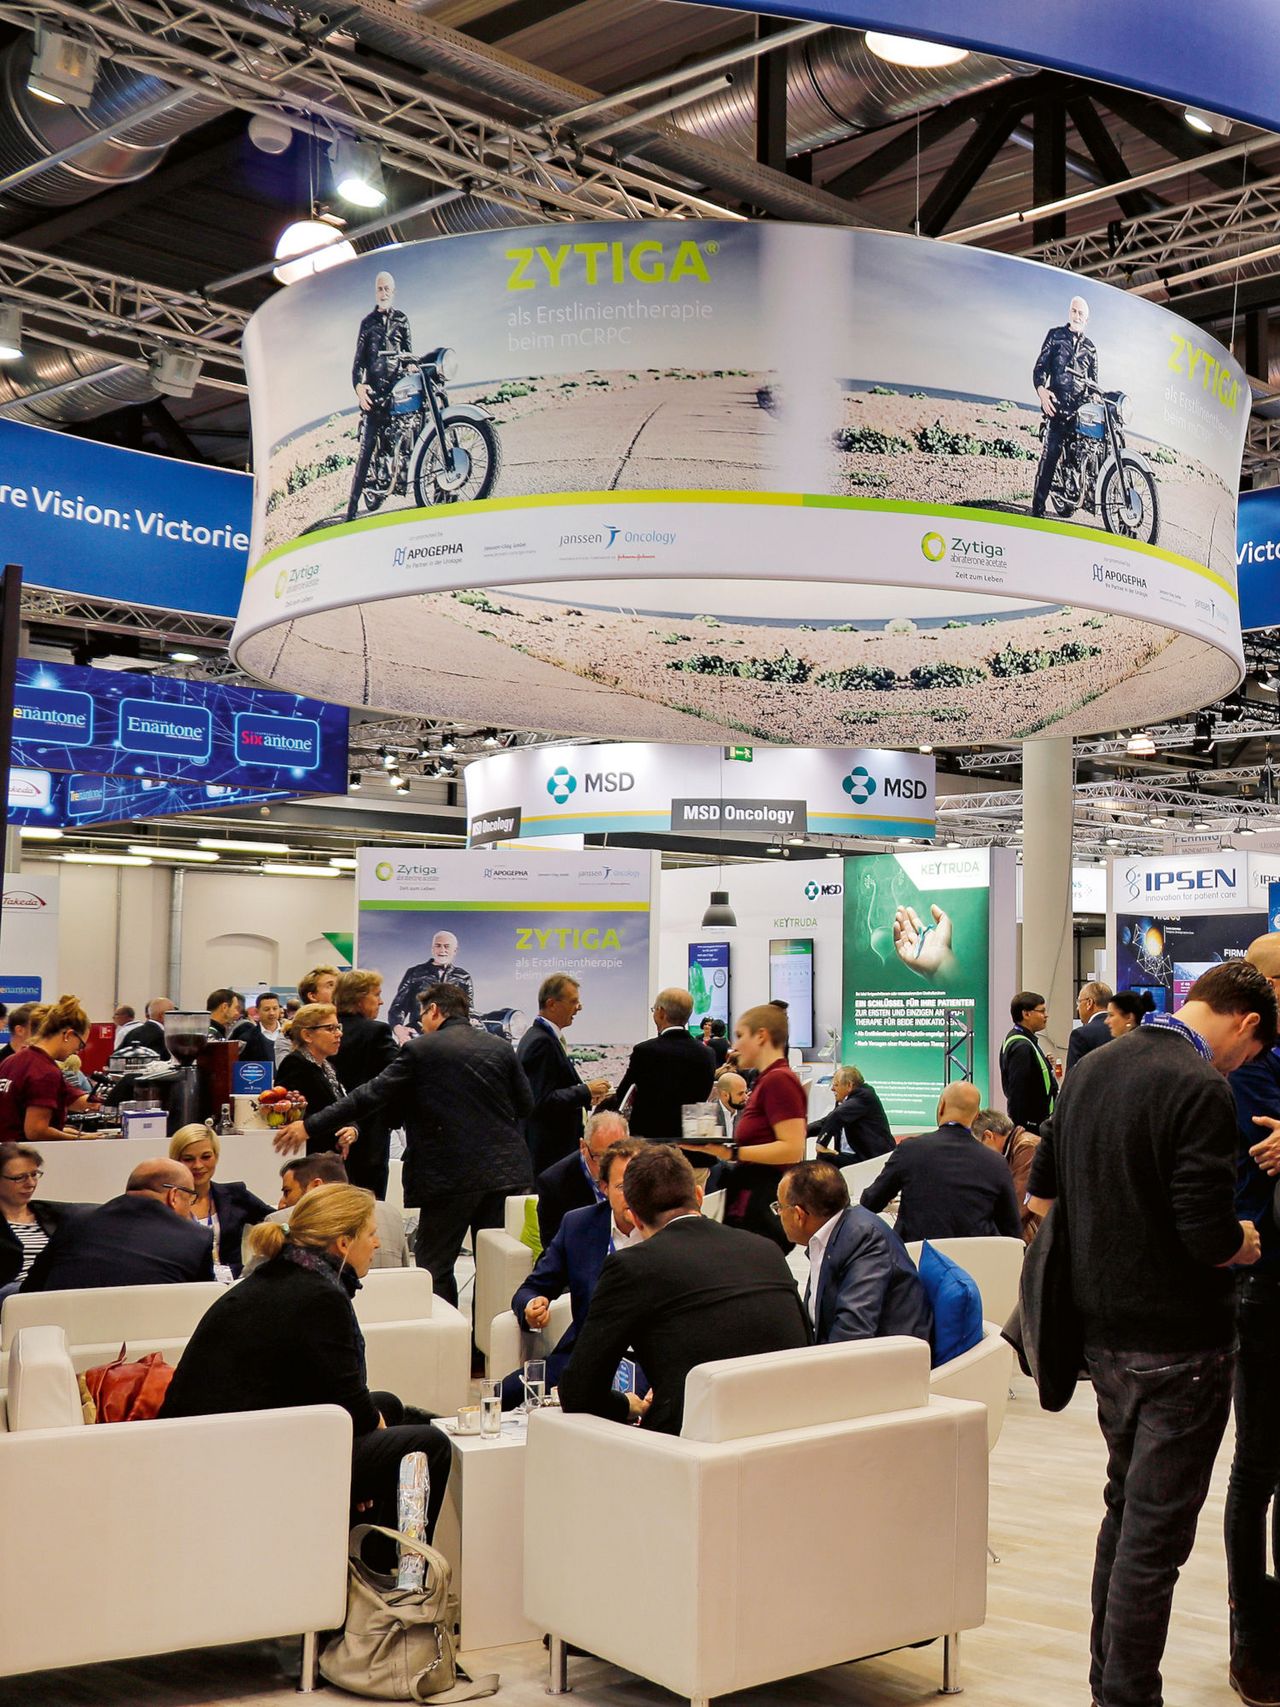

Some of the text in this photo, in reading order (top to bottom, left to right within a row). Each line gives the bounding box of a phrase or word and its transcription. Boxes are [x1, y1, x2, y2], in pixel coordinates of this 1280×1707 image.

[507, 299, 713, 327] als Erstlinientherapie
[508, 326, 633, 352] beim mCRPC
[31, 486, 130, 531] Vision:
[624, 530, 676, 545] Oncology
[407, 543, 464, 560] APOGEPHA
[951, 537, 1004, 558] Zytiga
[289, 563, 320, 583] Zytiga
[955, 571, 968, 579] Zeit
[984, 575, 1004, 583] Leben
[1105, 569, 1147, 589] APOGEPHA
[127, 715, 203, 738] Enantone
[241, 730, 312, 751] Sixantone
[584, 772, 635, 793] MSD
[883, 777, 928, 799] MSD
[683, 804, 795, 825] MSD Oncology
[482, 816, 514, 833] Oncology
[396, 864, 437, 876] Zytiga
[493, 869, 529, 877] APOGEPHA
[920, 860, 980, 875] KEYTRUDA
[1145, 868, 1237, 892] IPSEN
[821, 884, 842, 896] MSD
[1183, 892, 1192, 901] for
[1194, 890, 1219, 902] patient
[1220, 891, 1237, 899] care
[773, 917, 819, 929] KEYTRUDA
[515, 957, 623, 969] als Erstlinientherapie
[906, 998, 919, 1007] FÜR
[937, 999, 975, 1007] PATIENTEN
[884, 1017, 896, 1025] FÜR
